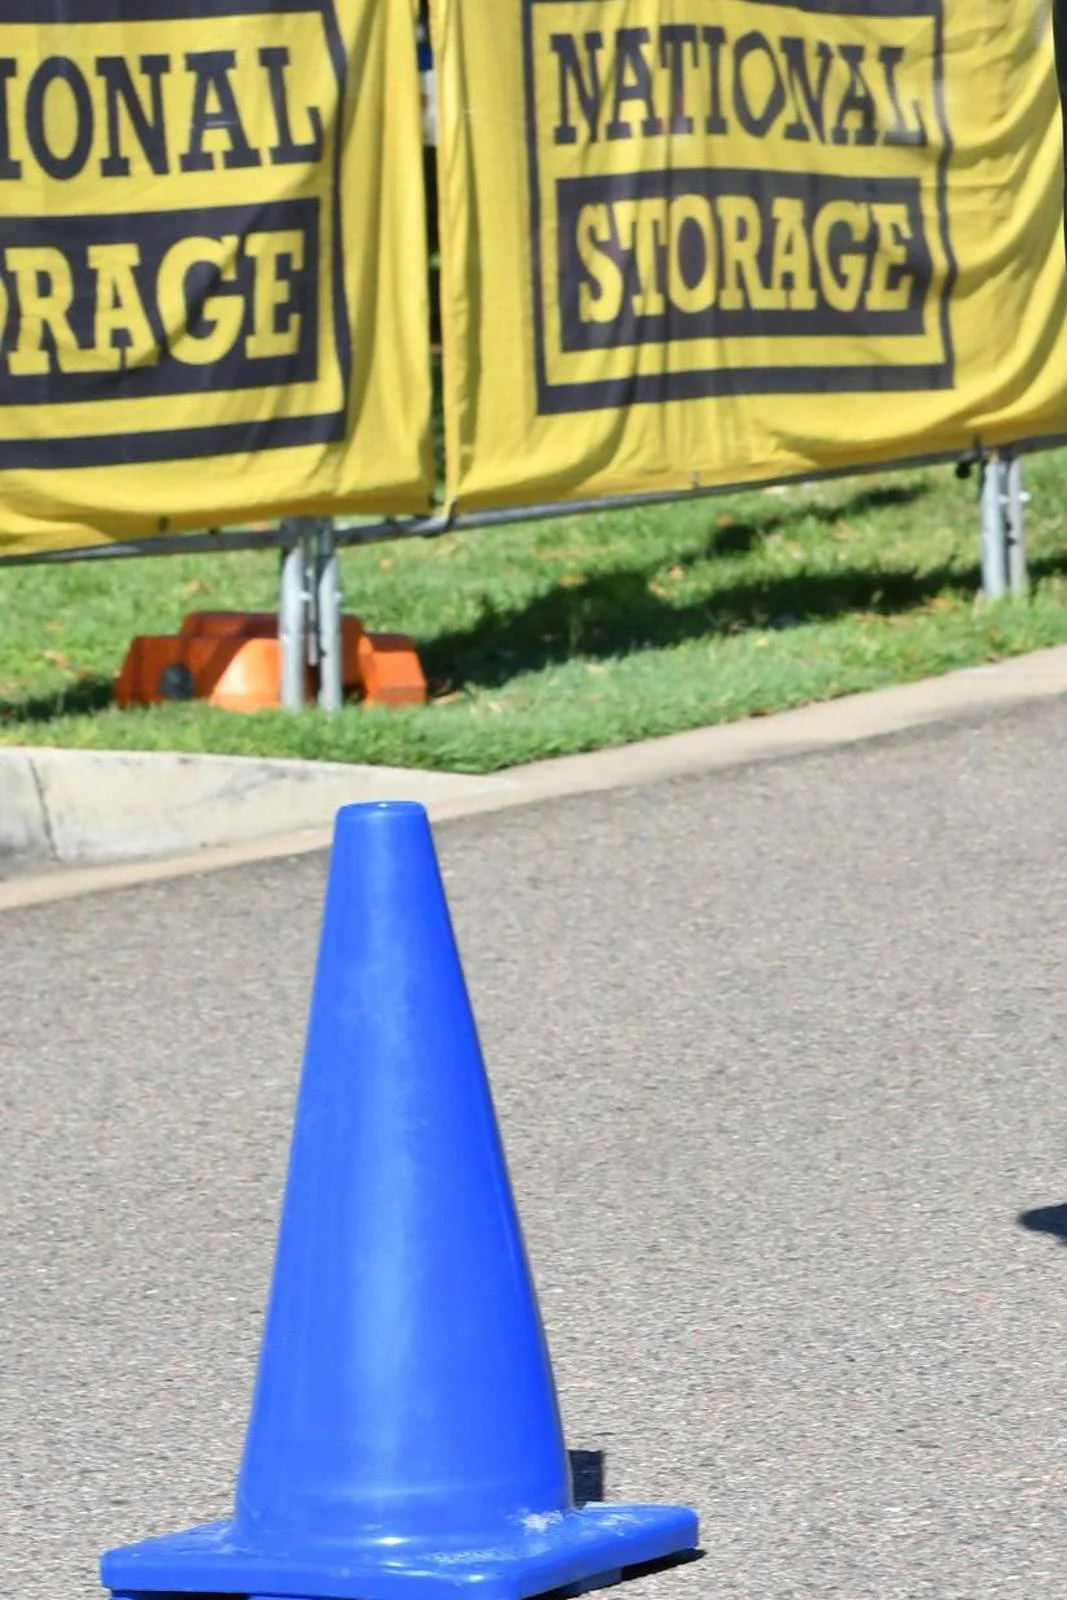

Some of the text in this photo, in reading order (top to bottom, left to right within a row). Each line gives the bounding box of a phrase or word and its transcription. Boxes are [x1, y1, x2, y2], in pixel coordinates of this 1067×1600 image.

[549, 23, 928, 147] NATIONAL
[0, 229, 305, 377] RAGE
[575, 193, 914, 325] STORAGE
